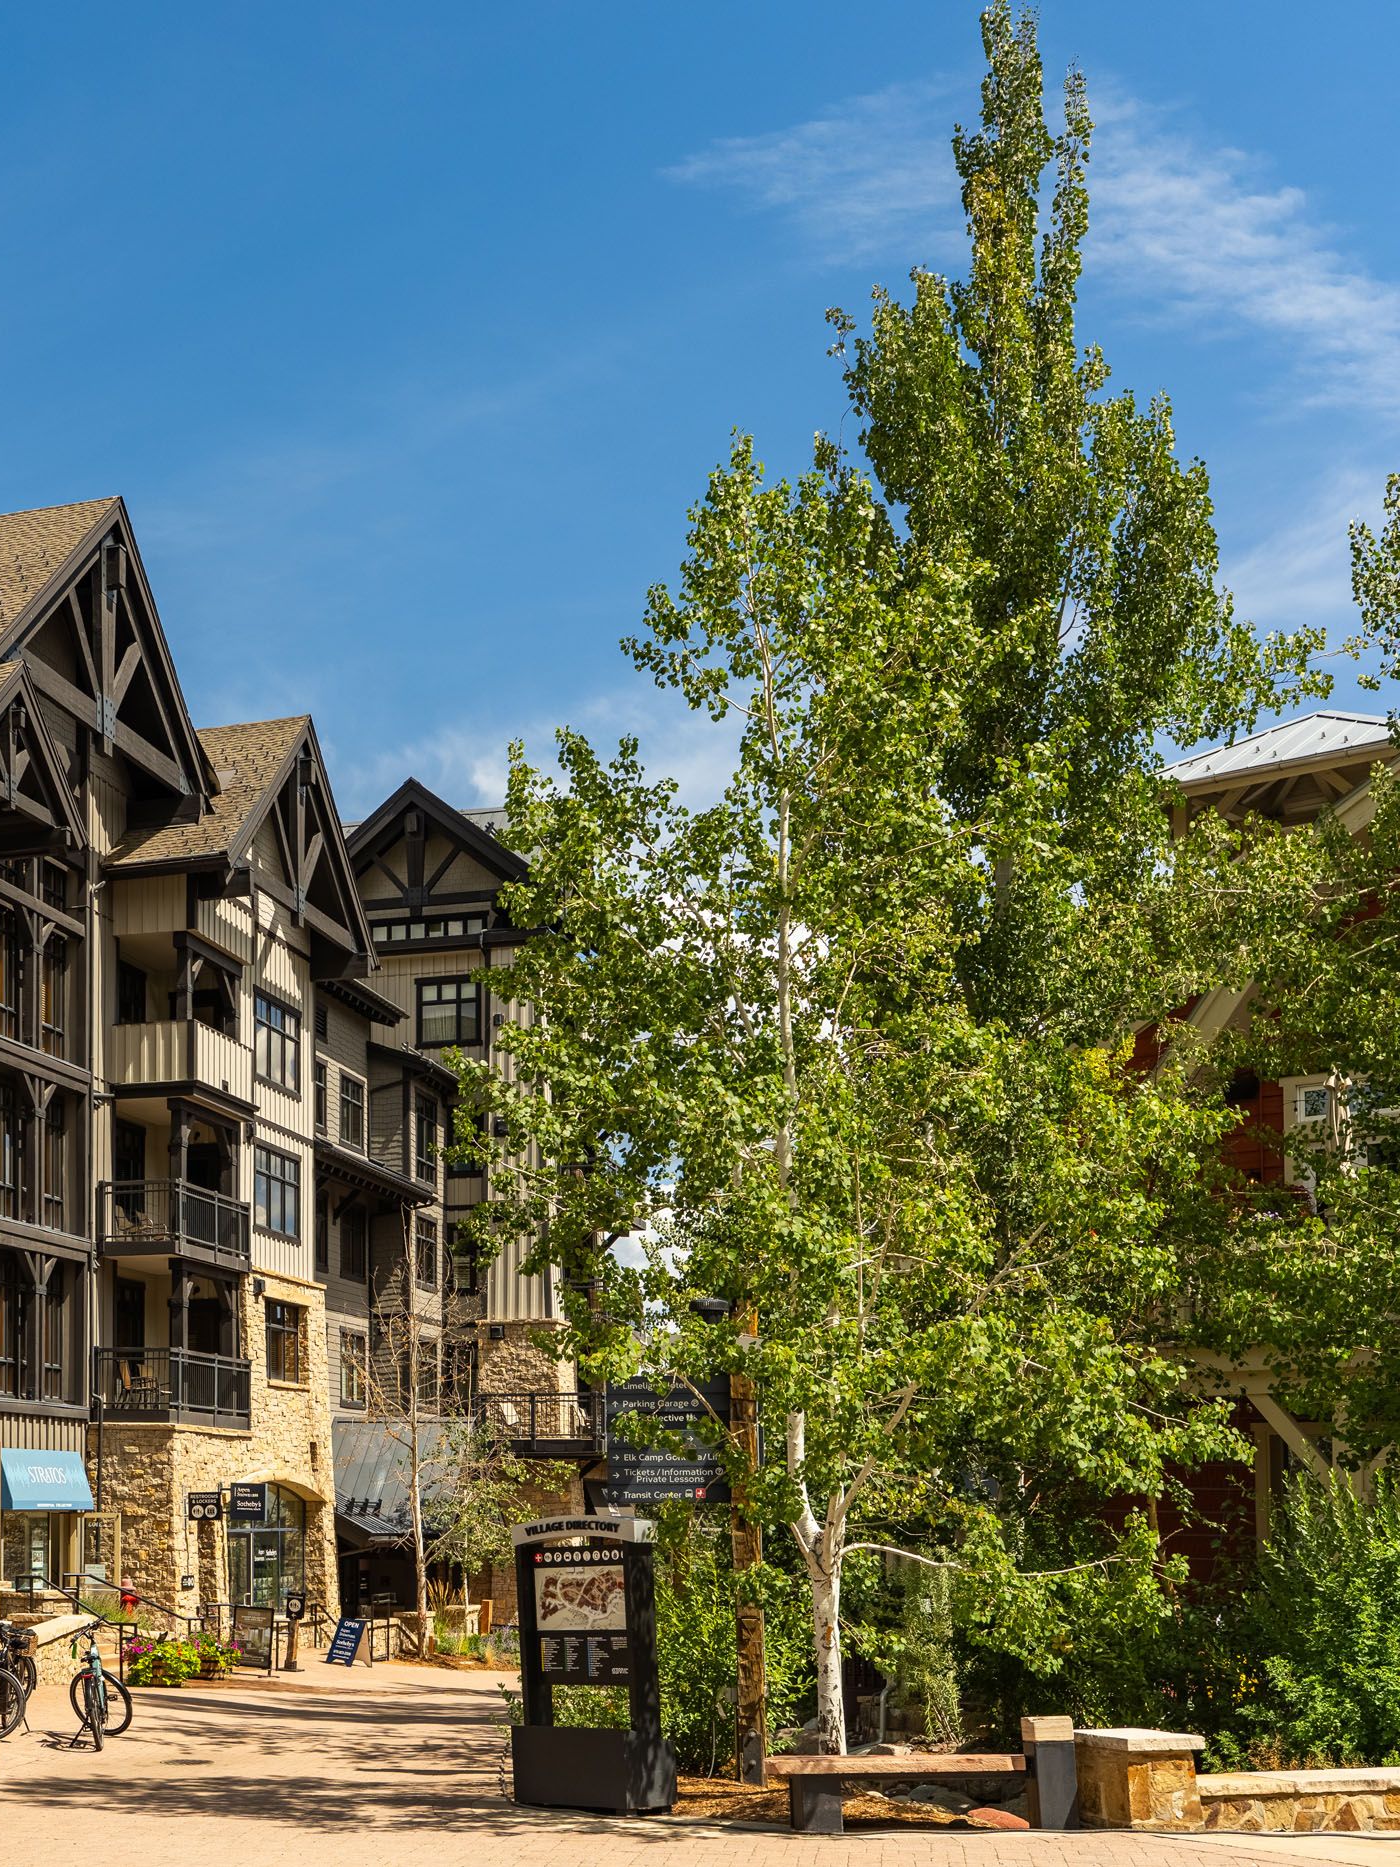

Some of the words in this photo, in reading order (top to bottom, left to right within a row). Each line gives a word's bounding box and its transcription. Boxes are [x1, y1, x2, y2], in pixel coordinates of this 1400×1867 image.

[622, 1382, 660, 1391] Limelig
[622, 1400, 655, 1409] Parking
[658, 1400, 689, 1409] Garage
[623, 1453, 637, 1461] Elk
[639, 1453, 664, 1462] Camp
[27, 1466, 67, 1484] STRATOS
[624, 1468, 655, 1476] Tickets
[662, 1468, 714, 1476] Information
[636, 1475, 668, 1483] Private
[669, 1475, 705, 1483] Lessons
[623, 1491, 652, 1499] Transit
[236, 1500, 262, 1509] Sotheby's
[524, 1521, 565, 1536] VILLAGE
[566, 1520, 620, 1533] DIRECTORY
[344, 1620, 360, 1629] OPEN
